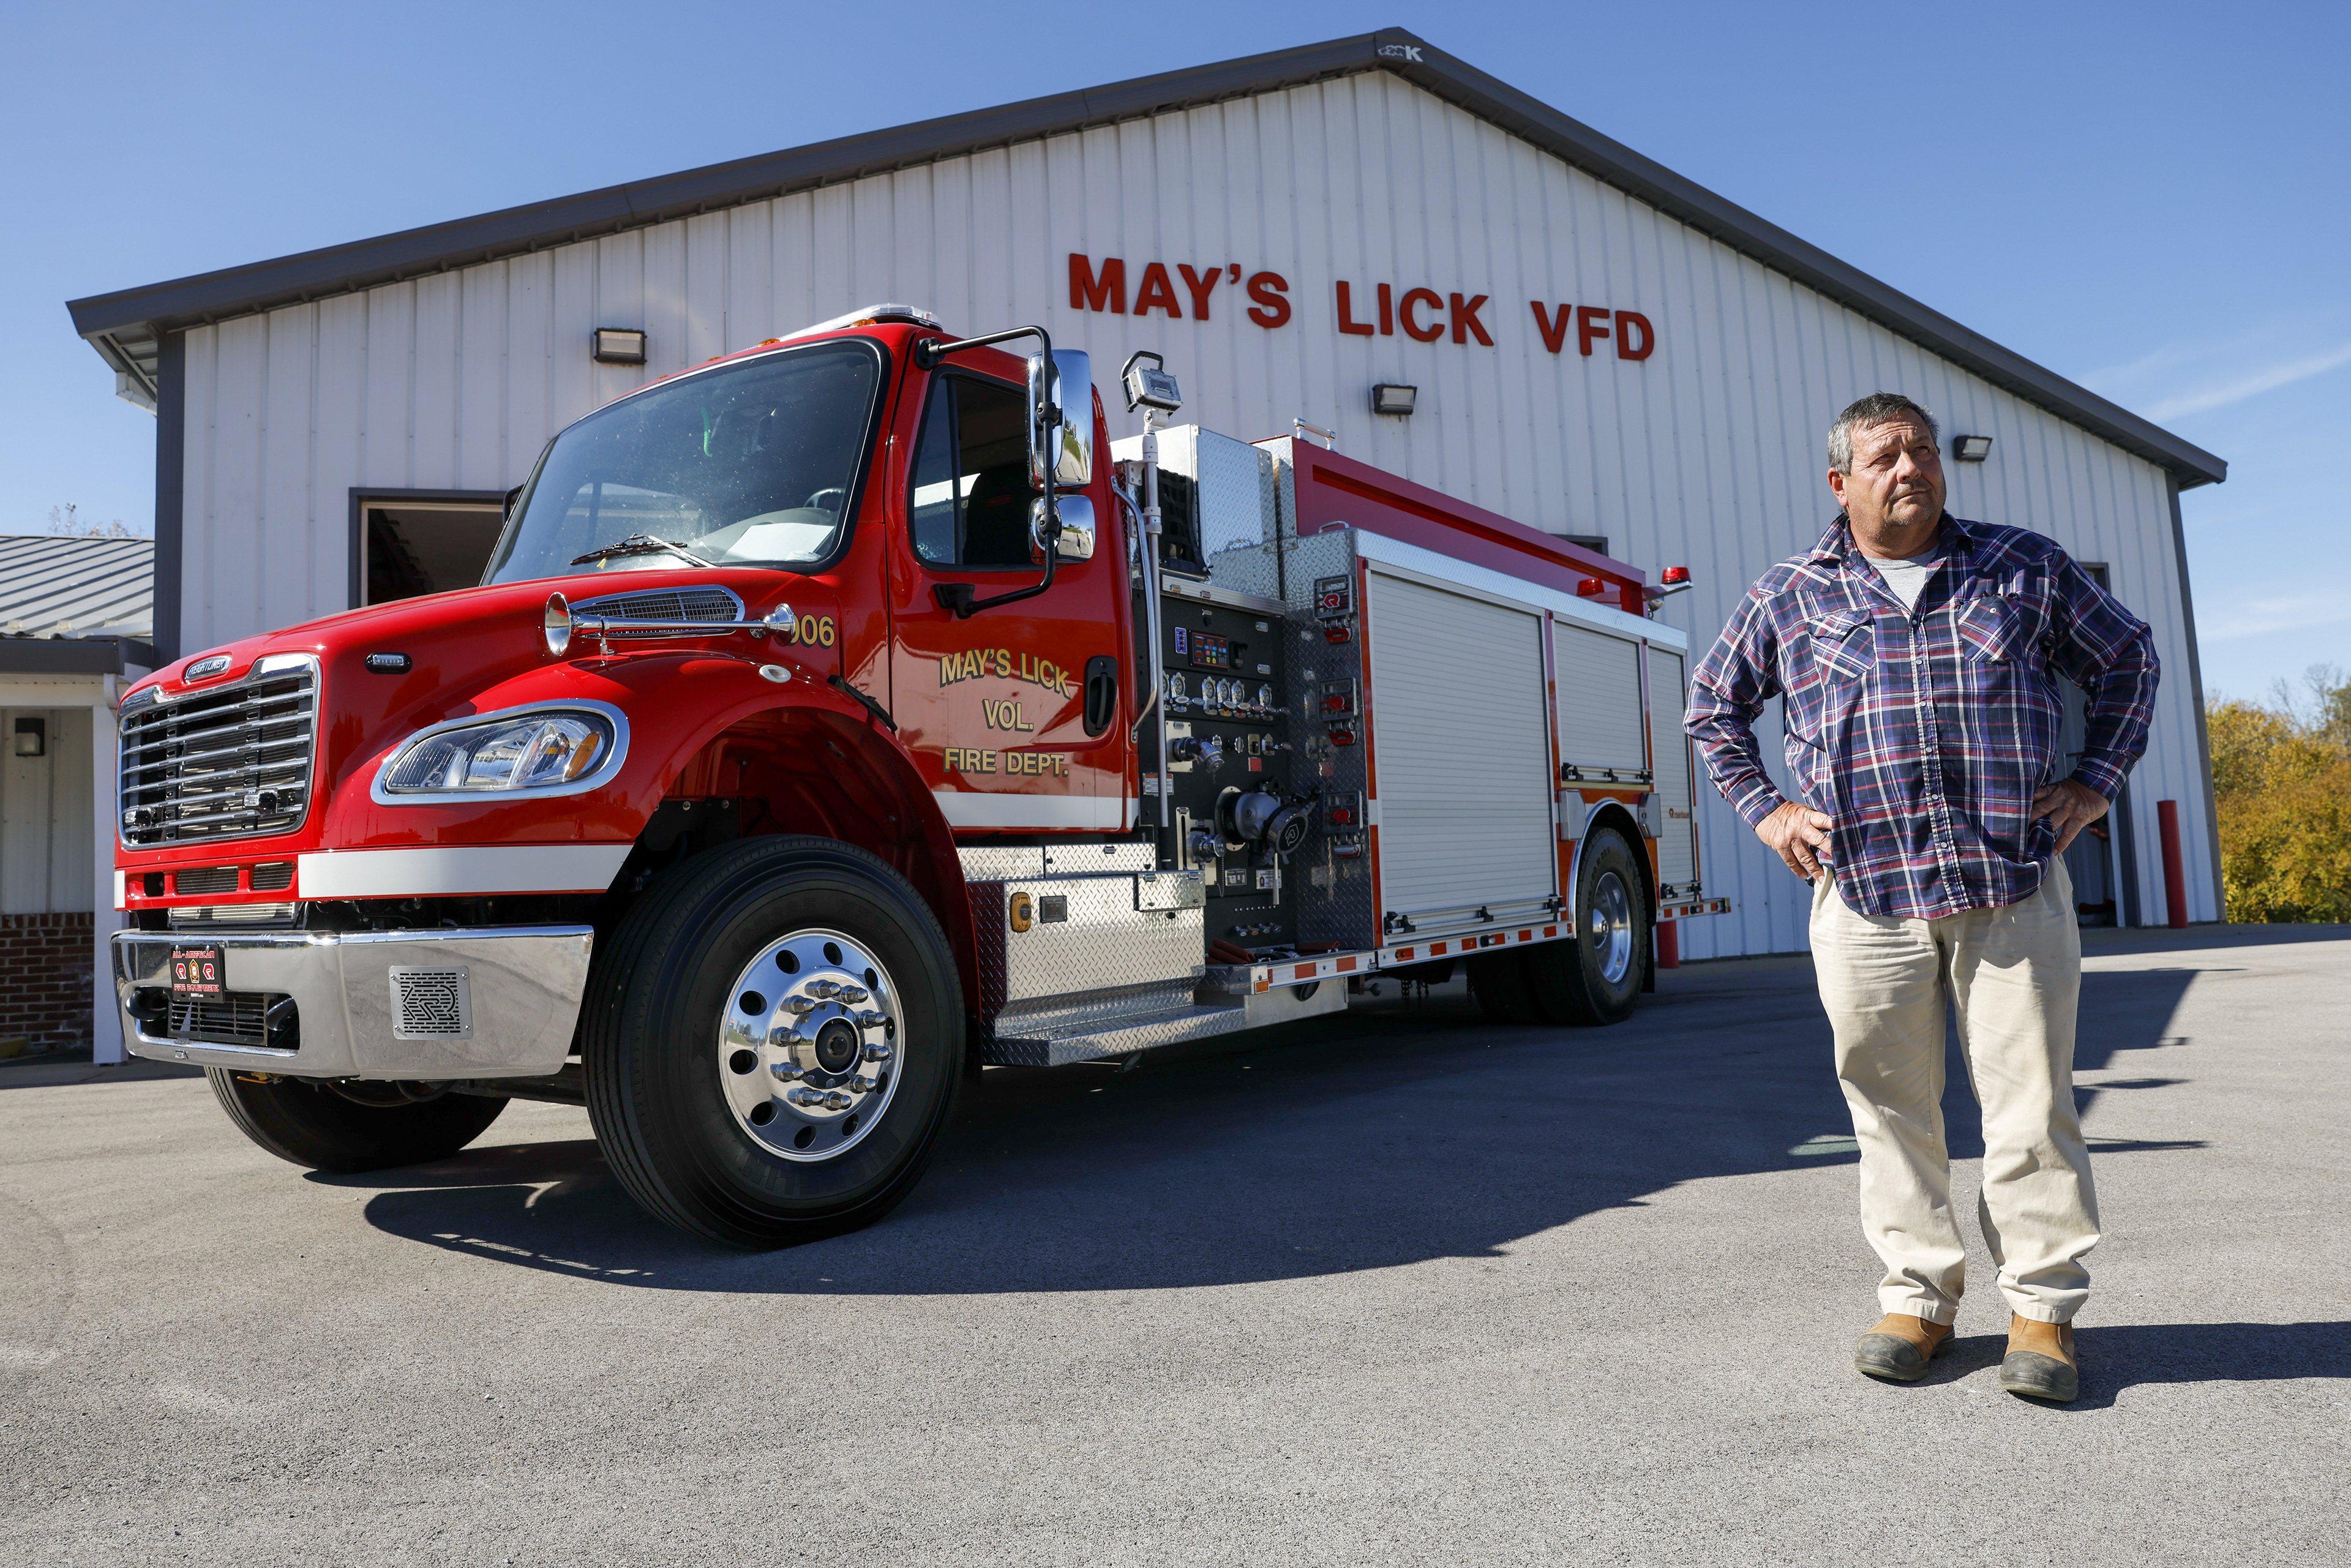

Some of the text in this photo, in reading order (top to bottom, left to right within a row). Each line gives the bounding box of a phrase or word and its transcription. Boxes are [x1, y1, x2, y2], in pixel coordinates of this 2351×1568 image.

[1068, 253, 1655, 361] MAY'S LICK VFD
[187, 659, 226, 676] FREIGHTLINER
[940, 648, 1071, 700] MAY'S LICK
[982, 699, 1034, 732] VOL.
[943, 747, 1070, 778] FIRE DEPT.
[172, 950, 216, 959] ALL-AMERICAN
[187, 984, 220, 992] EQUIPMENT
